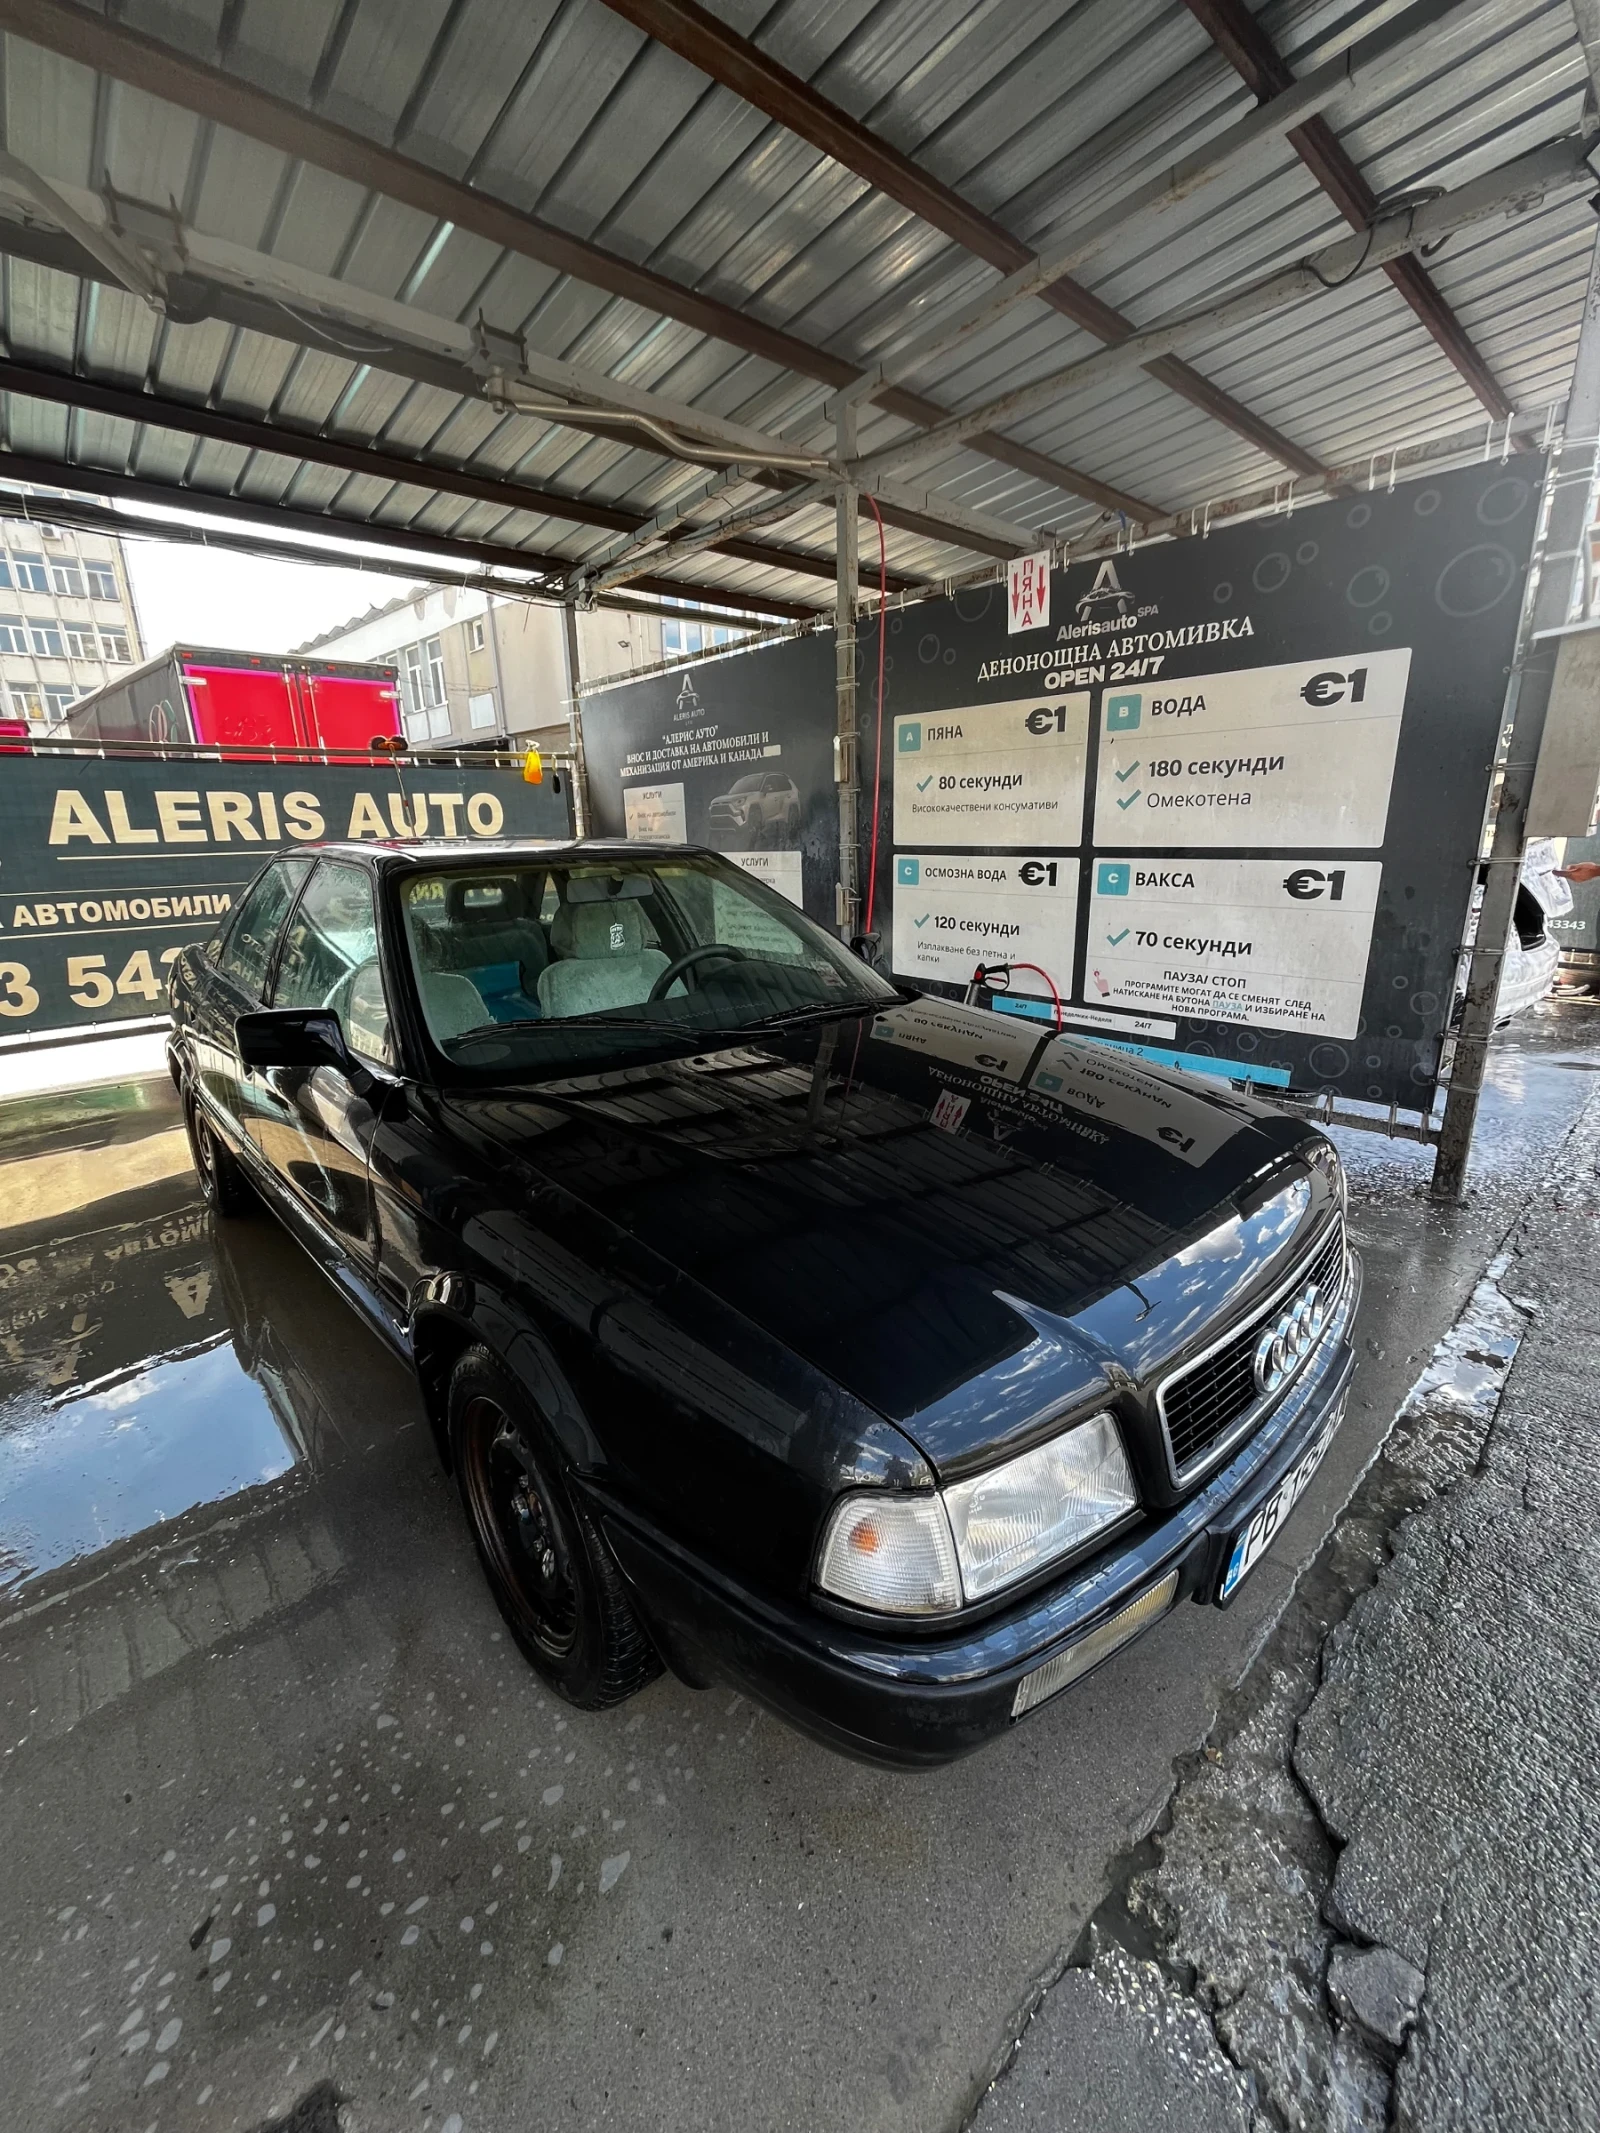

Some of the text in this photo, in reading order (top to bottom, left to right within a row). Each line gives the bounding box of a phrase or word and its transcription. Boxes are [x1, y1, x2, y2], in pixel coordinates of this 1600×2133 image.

[1021, 559, 1034, 627] ПЯНА
[1056, 605, 1159, 642] Alerisauto SPA
[977, 616, 1255, 683] ДЕНОНОЩНА АВТОМИВКА
[1044, 656, 1165, 690] OPEN 24/7
[1300, 668, 1369, 707] €1
[674, 708, 706, 721] ALERIS AUTO
[1119, 706, 1129, 717] B
[1151, 695, 1206, 717] ВОДА
[1024, 705, 1067, 735] €1
[906, 732, 913, 741] A
[927, 725, 963, 741] ПЯНА
[627, 731, 769, 764] ВНОС И ДОСТАВКА НА АВТОМОБИЛИ И
[620, 760, 671, 777] МЕХАНИЗАЦИЯ
[672, 759, 681, 771] ОТ
[682, 754, 719, 769] АМЕРИКА
[720, 752, 727, 762] И
[1149, 756, 1285, 778] 180 секунди
[938, 774, 1023, 791] 80 секунди
[912, 801, 1059, 814] Висококачествени консумативи
[1147, 792, 1251, 809] Омекотена
[48, 789, 504, 844] ALERIS AUTO
[741, 857, 769, 867] УСЛУГИ
[925, 867, 1007, 882] ОСМОЗНА ВОДА
[1018, 861, 1058, 887] €1
[1135, 871, 1195, 889] ВАКСА
[1282, 868, 1346, 901] €1
[12, 894, 232, 928] АВТОМОБИЛИ
[934, 916, 1020, 938] 120 секунди
[917, 940, 1016, 960] Изплакване без петна и
[1135, 930, 1253, 959] 70 секунди
[917, 954, 940, 964] капки
[1164, 970, 1247, 990] ПАУЗА/ СТОП
[1112, 987, 1326, 1022] НАТИСКАНЕ НА БУТОНА ПАУЗА И ИЗБИРАНЕ НА
[1124, 980, 1312, 1012] ПРОГРАМИТЕ МОГАТ ДА СЕ СМЕНЯТ СЛЕД
[1172, 1004, 1250, 1022] НОВА ПРОГРАМА.
[1134, 1021, 1153, 1030] 24/7
[1137, 1047, 1144, 1056] 2
